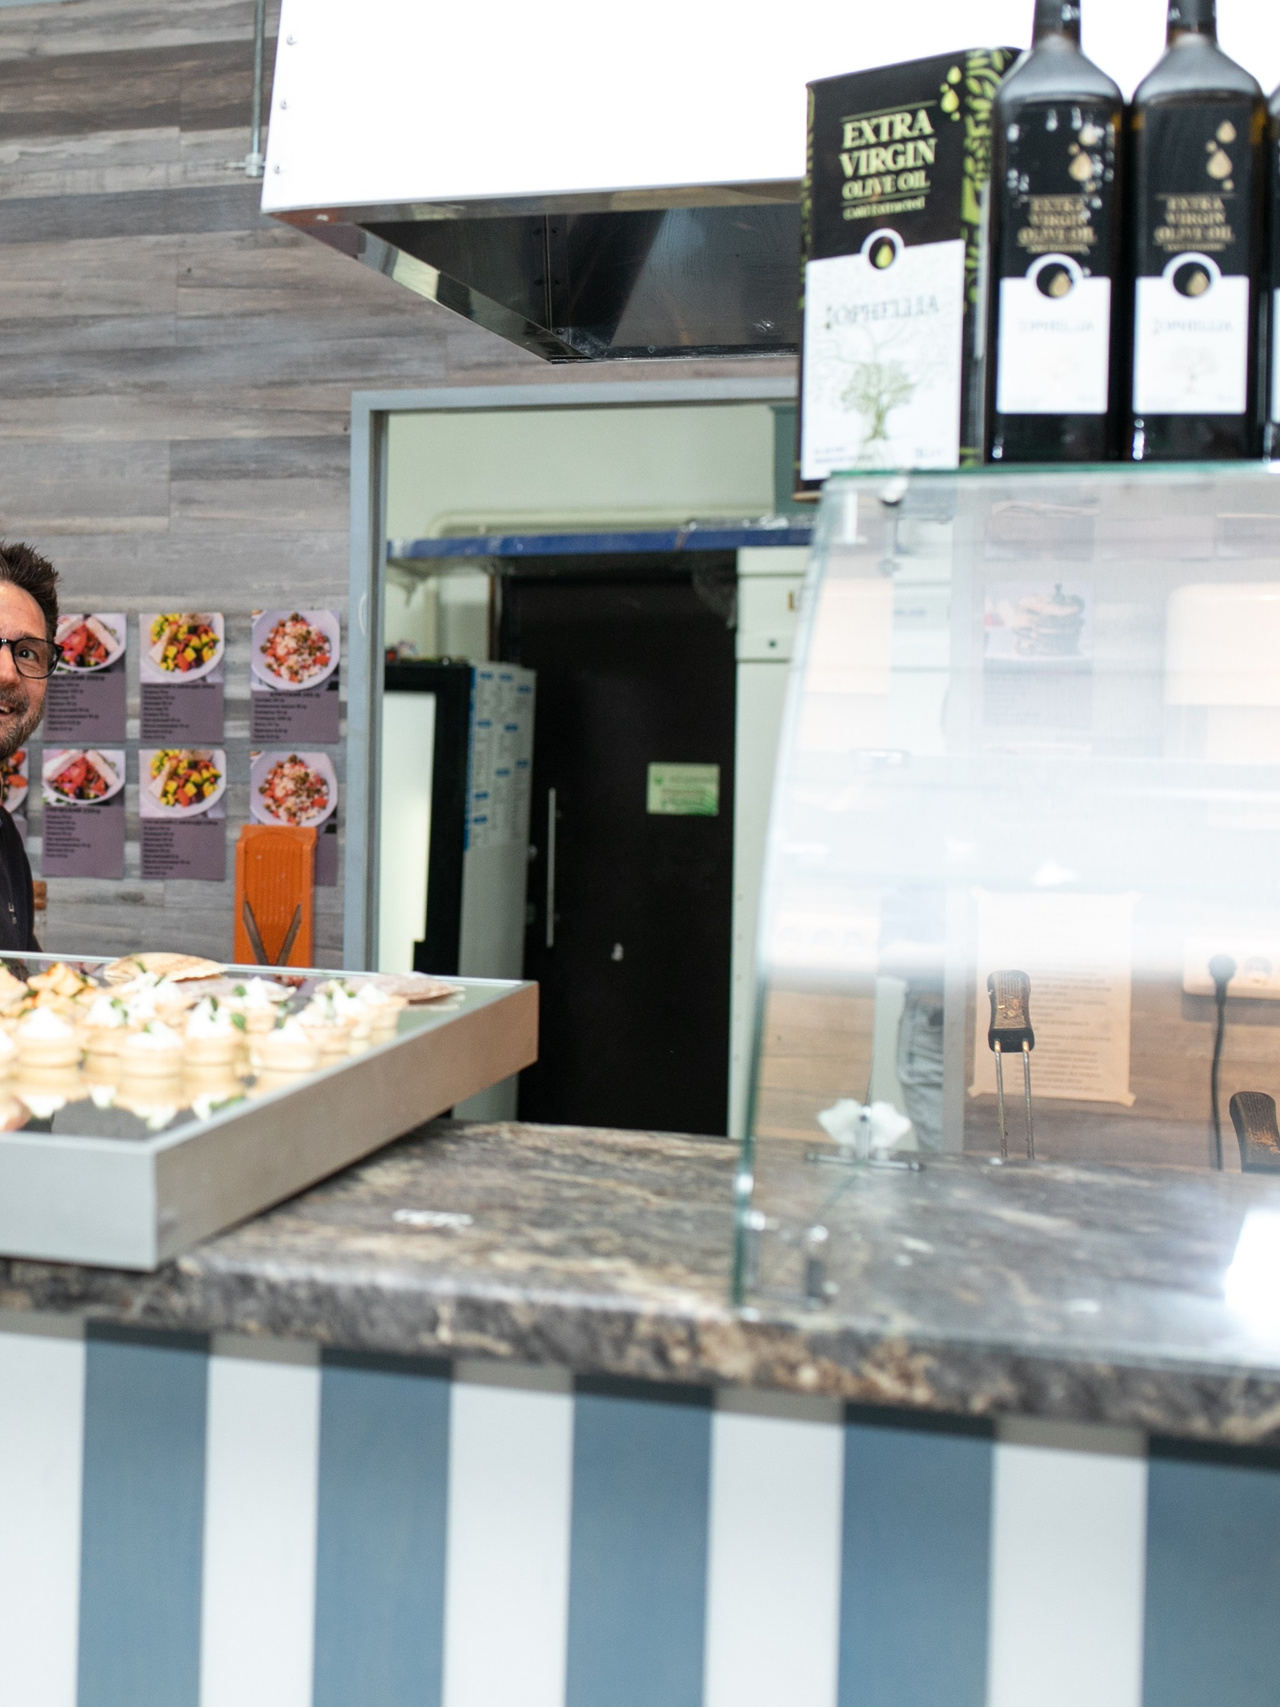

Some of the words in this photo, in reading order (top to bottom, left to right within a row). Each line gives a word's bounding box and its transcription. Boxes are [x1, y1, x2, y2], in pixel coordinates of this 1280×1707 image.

[841, 109, 935, 149] EXTRA
[839, 137, 938, 178] VIRGIN
[842, 174, 897, 200] OLIVE
[897, 169, 931, 191] OIL
[1165, 211, 1225, 225] VIRGIN
[1166, 198, 1225, 210] EXTRA
